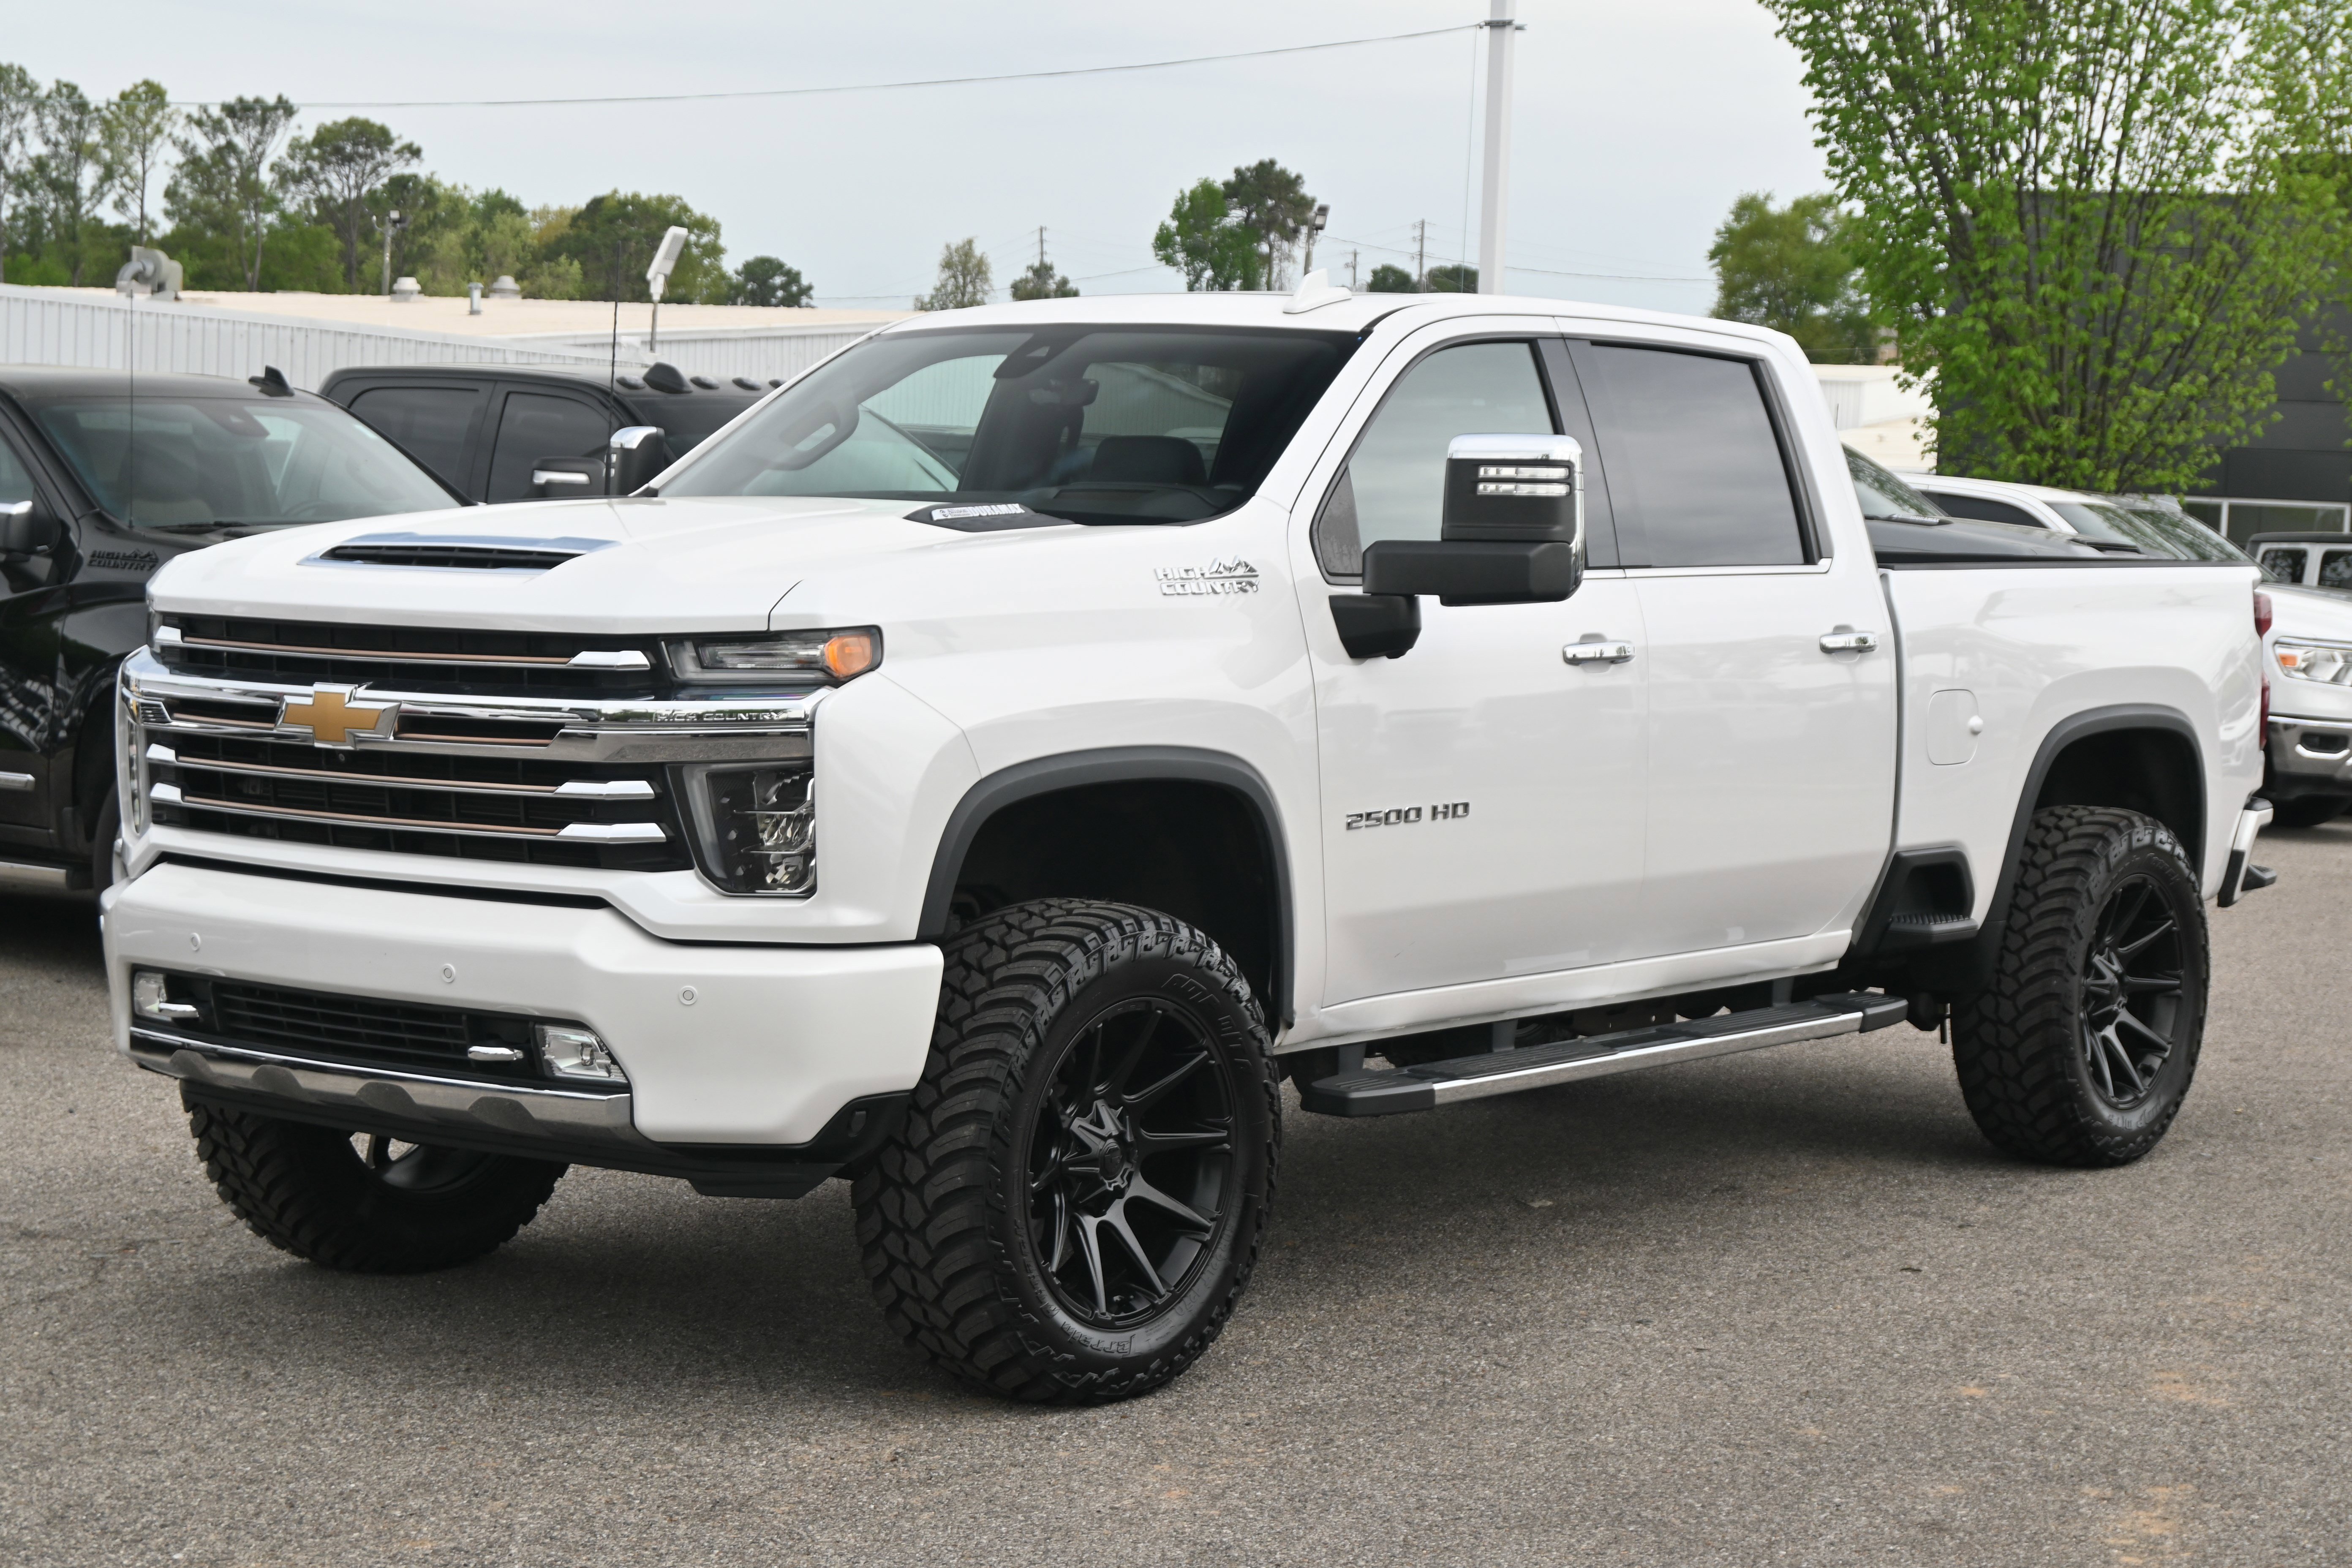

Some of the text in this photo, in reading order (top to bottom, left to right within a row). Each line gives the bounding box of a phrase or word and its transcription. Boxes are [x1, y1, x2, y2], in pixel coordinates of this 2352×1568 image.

[970, 503, 1025, 517] DURAMAX
[88, 558, 156, 571] COUNTRY
[1154, 566, 1210, 580] HIGH
[1160, 580, 1260, 596] COUNTRY
[657, 710, 787, 722] HIGH COUNTRY
[1346, 801, 1470, 830] 2500 HD
[1060, 1321, 1137, 1359] Terrain
